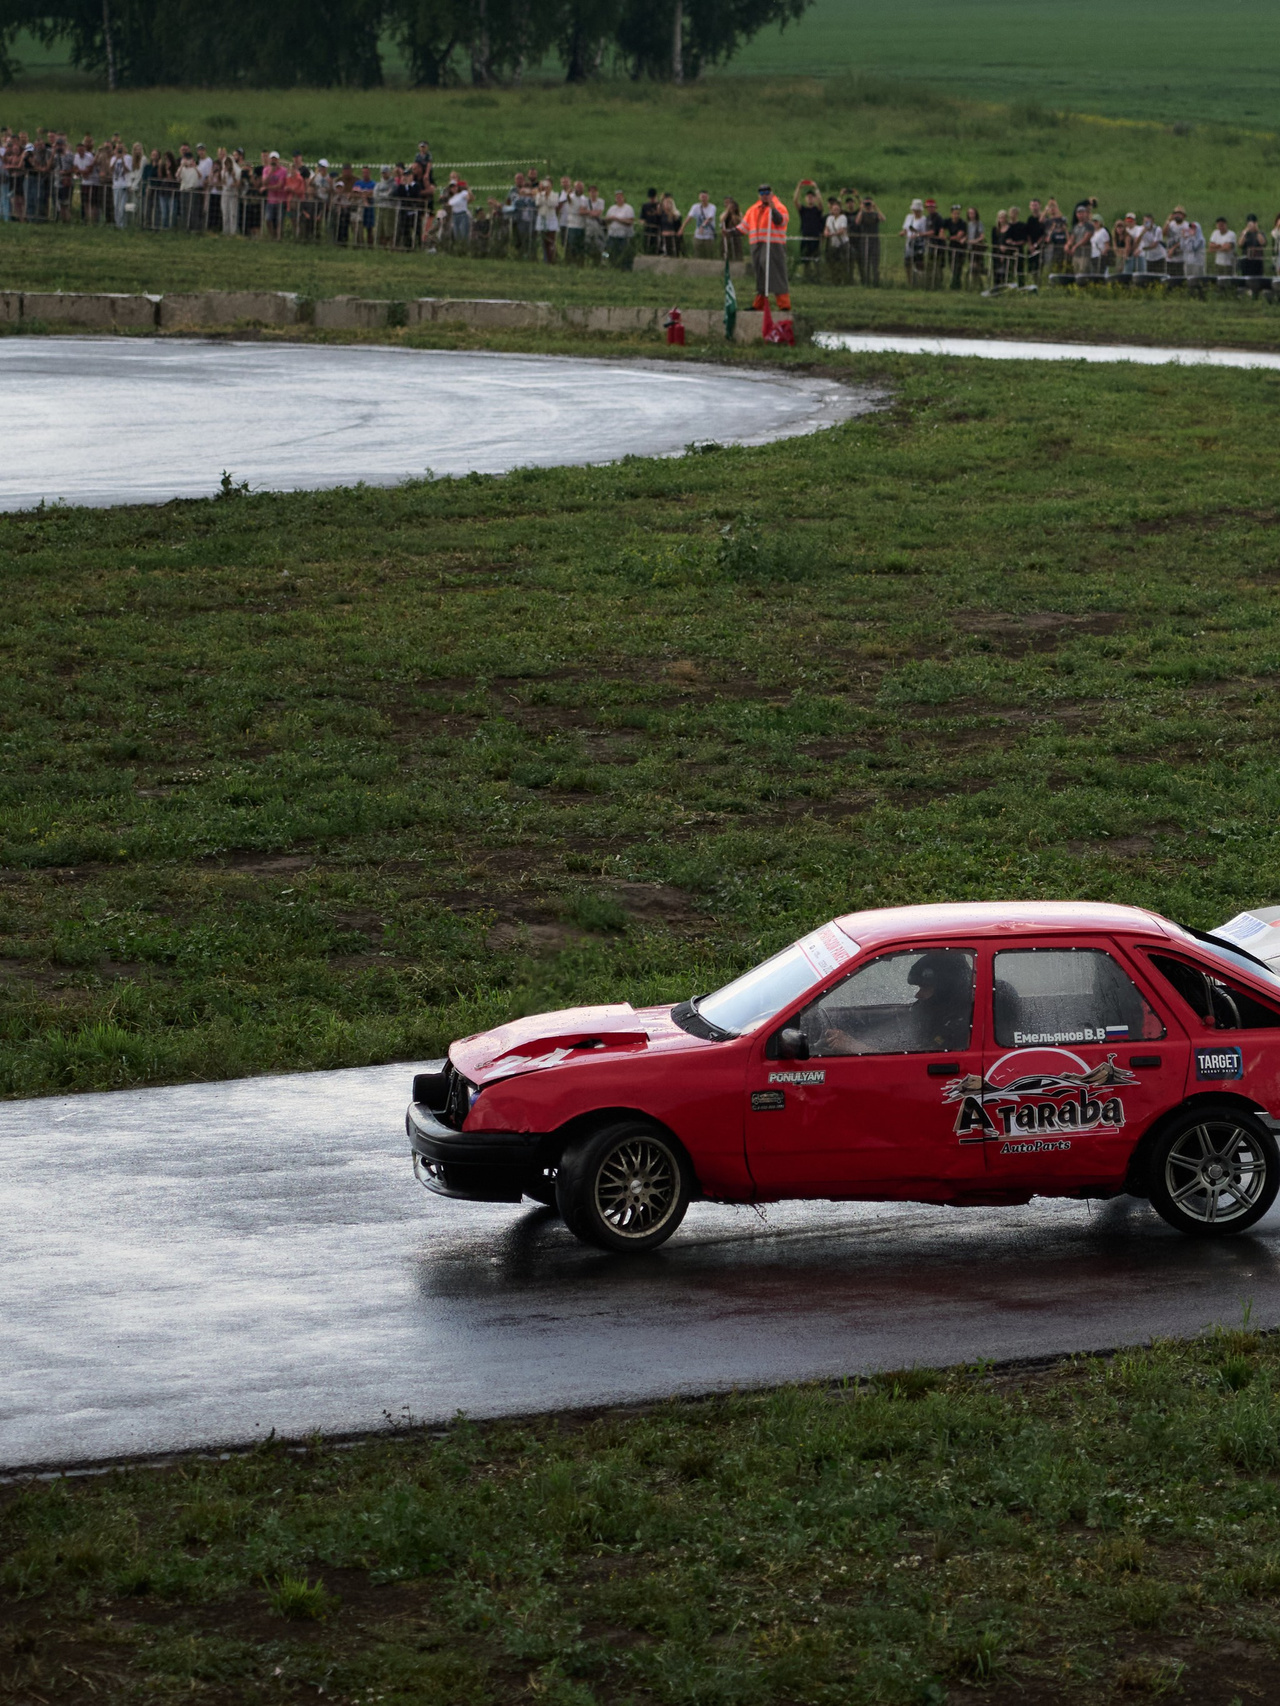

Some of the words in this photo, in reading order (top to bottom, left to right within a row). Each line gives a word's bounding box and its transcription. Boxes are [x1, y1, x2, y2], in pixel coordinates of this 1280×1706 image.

[1013, 1030, 1083, 1044] Емельянов
[482, 1048, 574, 1079] 24
[1197, 1054, 1239, 1069] TARGET
[769, 1071, 826, 1083] PONULYAM
[1000, 1140, 1071, 1155] AutoParts
